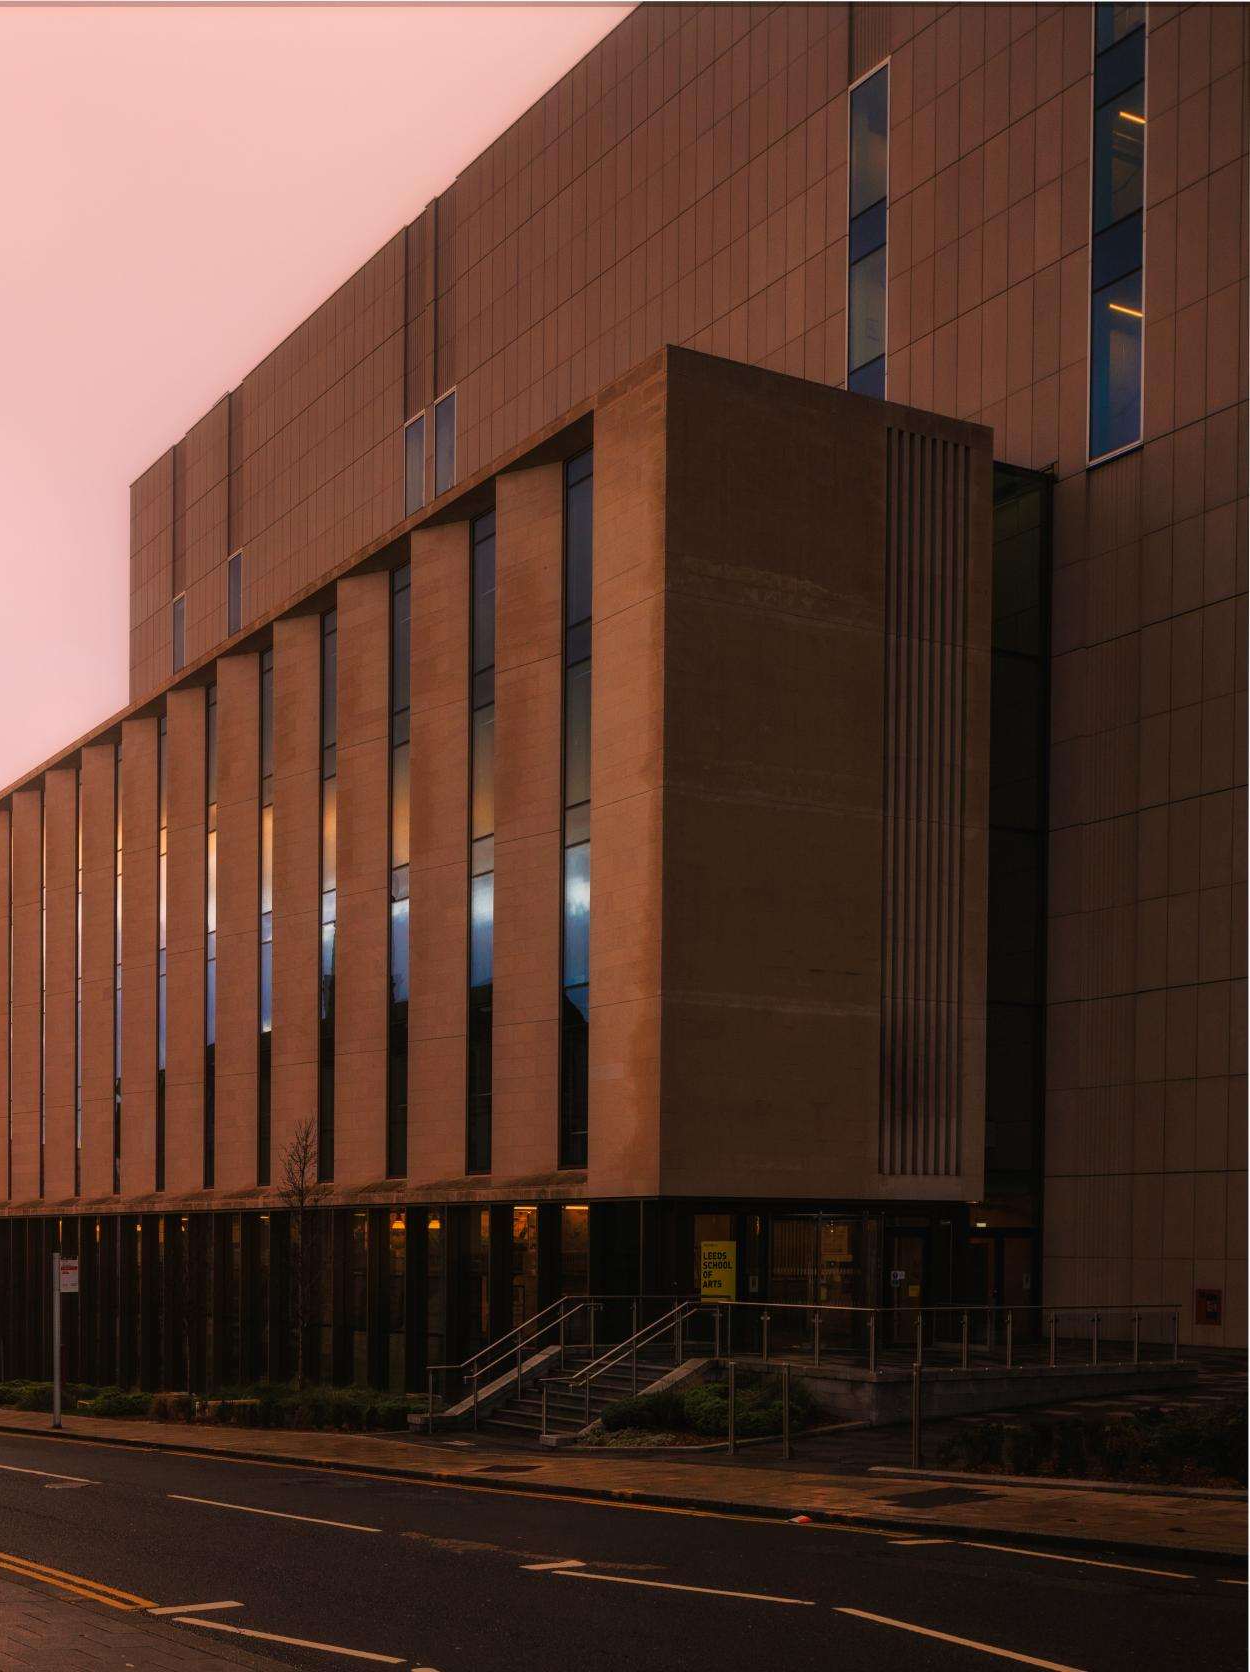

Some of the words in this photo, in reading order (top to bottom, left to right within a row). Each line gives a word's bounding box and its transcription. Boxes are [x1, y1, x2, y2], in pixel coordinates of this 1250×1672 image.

[703, 1252, 727, 1260] LEEDS
[703, 1261, 733, 1270] SCHOOL
[703, 1270, 713, 1279] OF
[703, 1280, 722, 1288] ARTS
